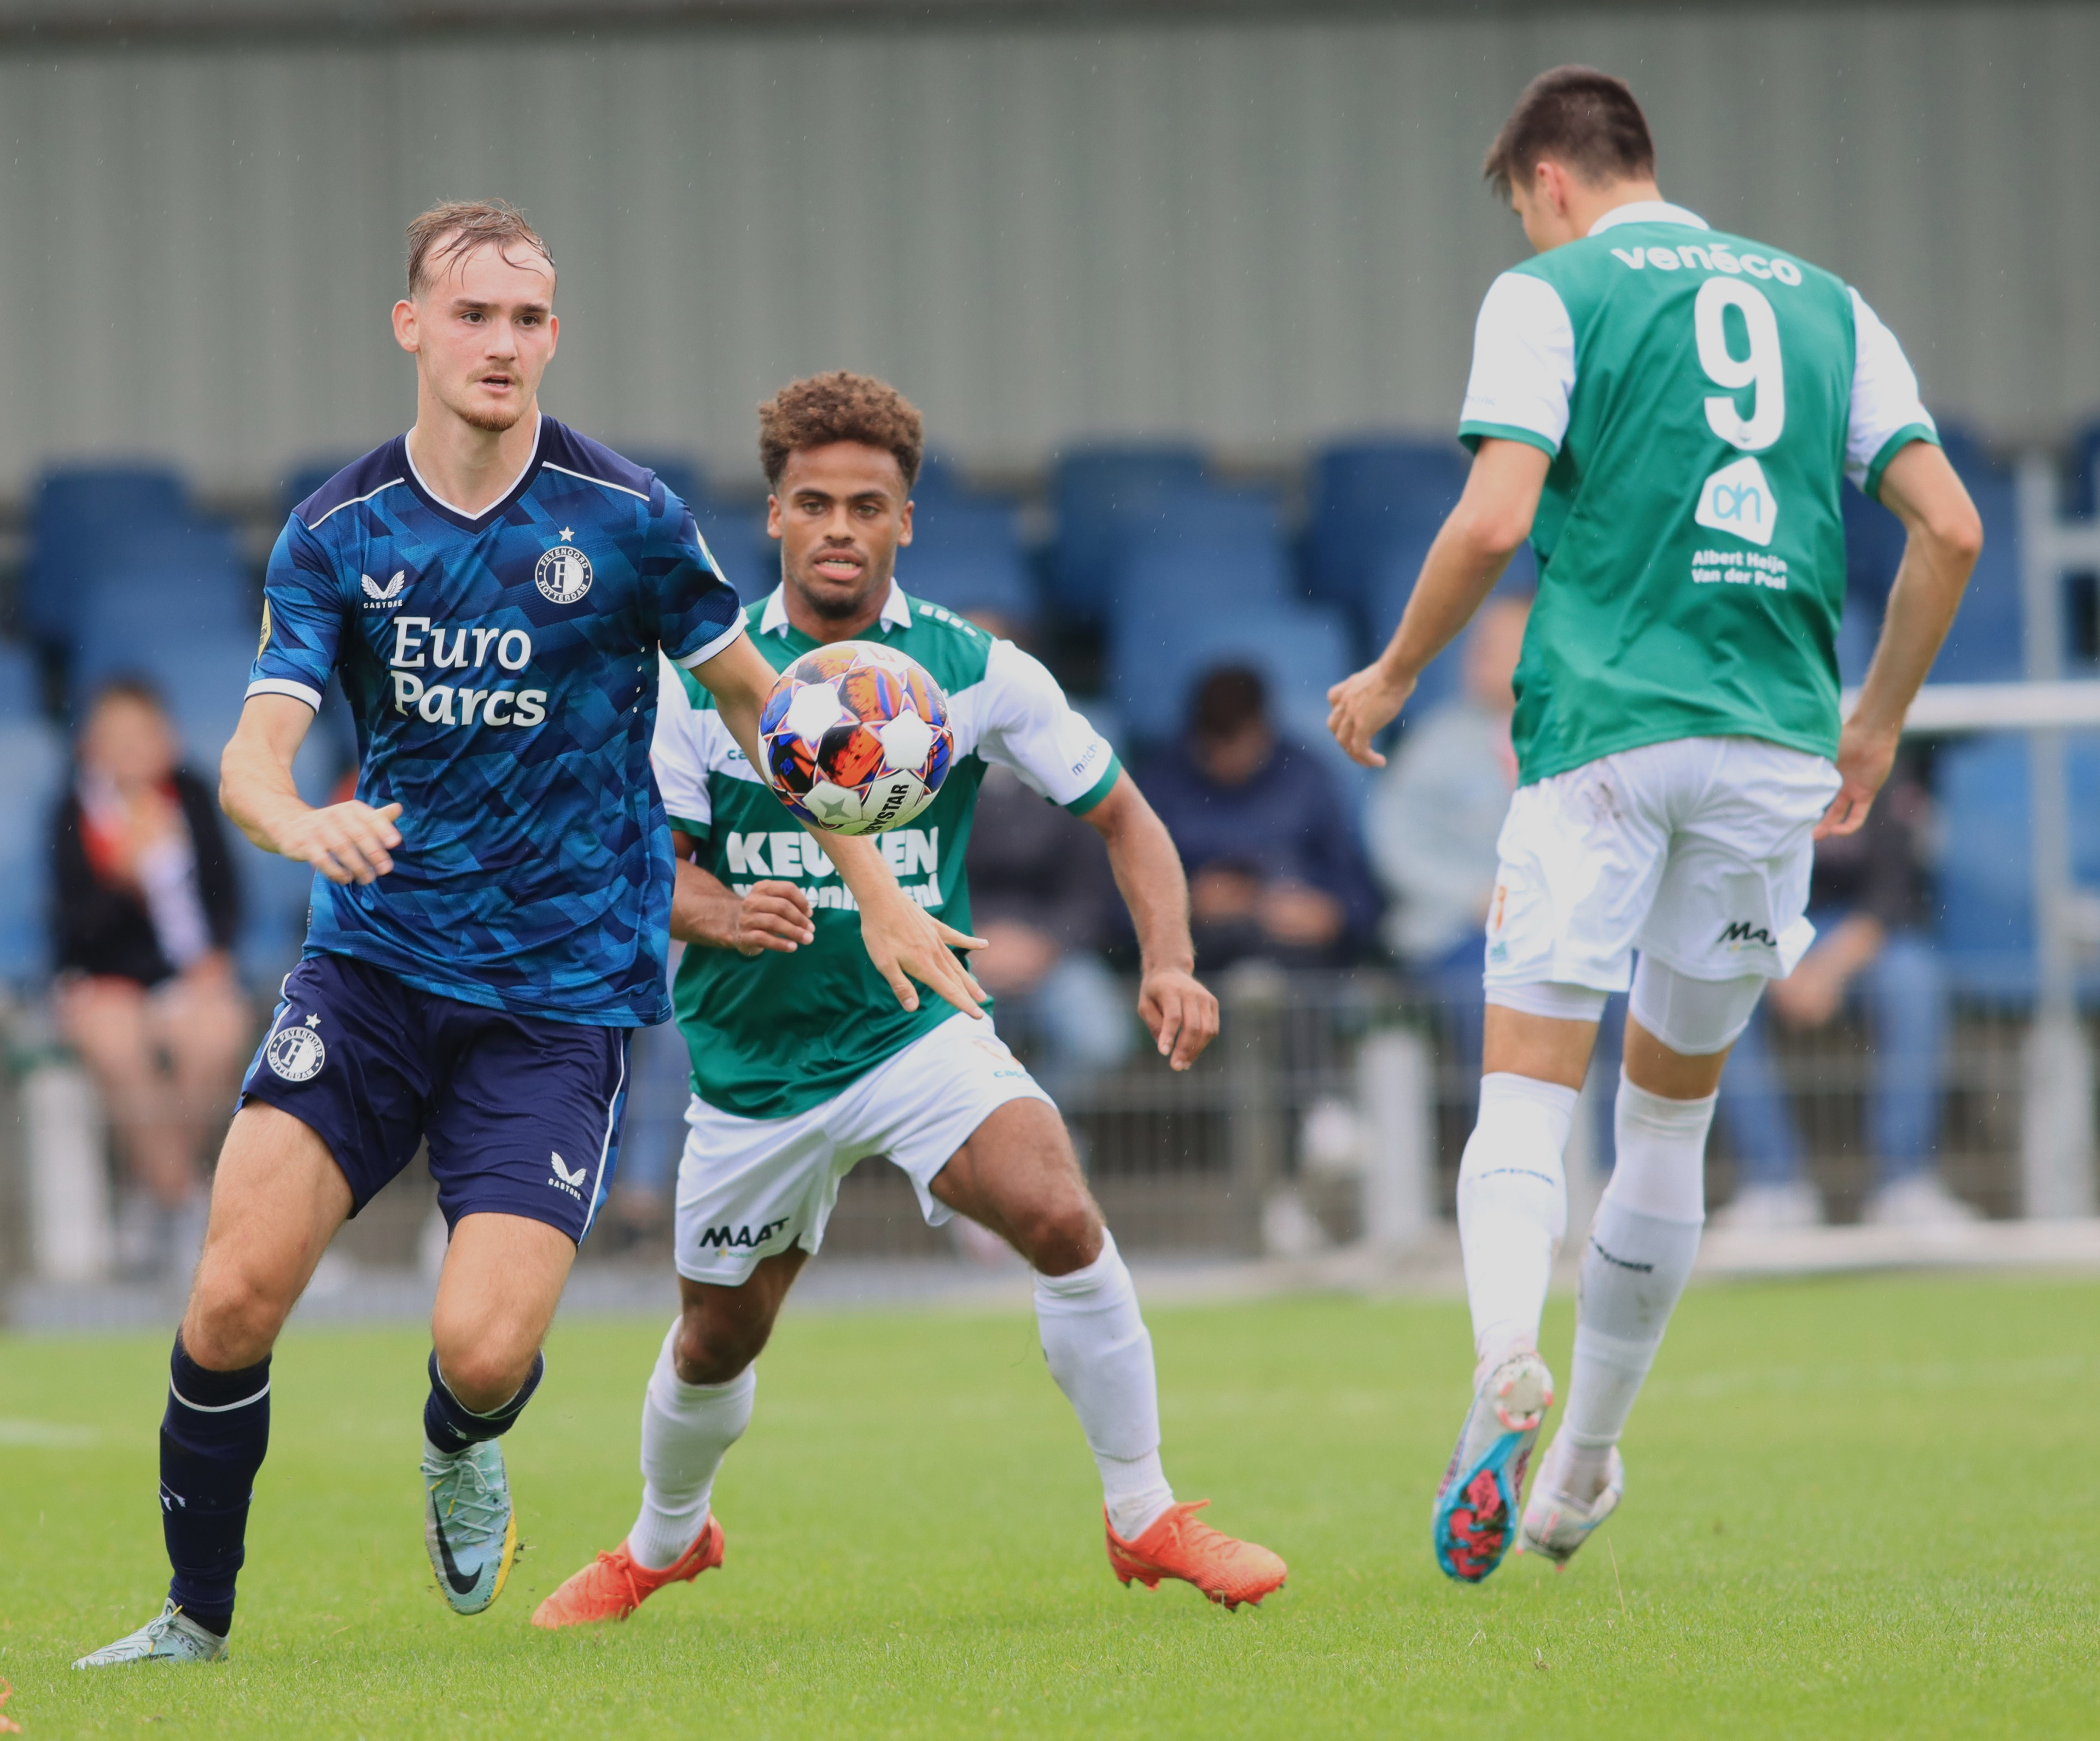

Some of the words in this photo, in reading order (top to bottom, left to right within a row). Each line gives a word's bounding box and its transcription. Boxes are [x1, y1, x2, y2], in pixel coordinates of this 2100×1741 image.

[1695, 276, 1786, 451] 9
[540, 548, 588, 569] FEYENOORD
[1691, 550, 1743, 566] Albert
[1747, 552, 1788, 574] Heijn
[1691, 568, 1721, 584] Van
[1724, 568, 1752, 585] der
[363, 599, 403, 609] CASTORE
[539, 580, 588, 601] ROTTERDAM
[390, 617, 532, 670] Euro
[390, 670, 547, 727] Parcs
[726, 826, 939, 878] KEUEN
[699, 1217, 790, 1247] MAAT
